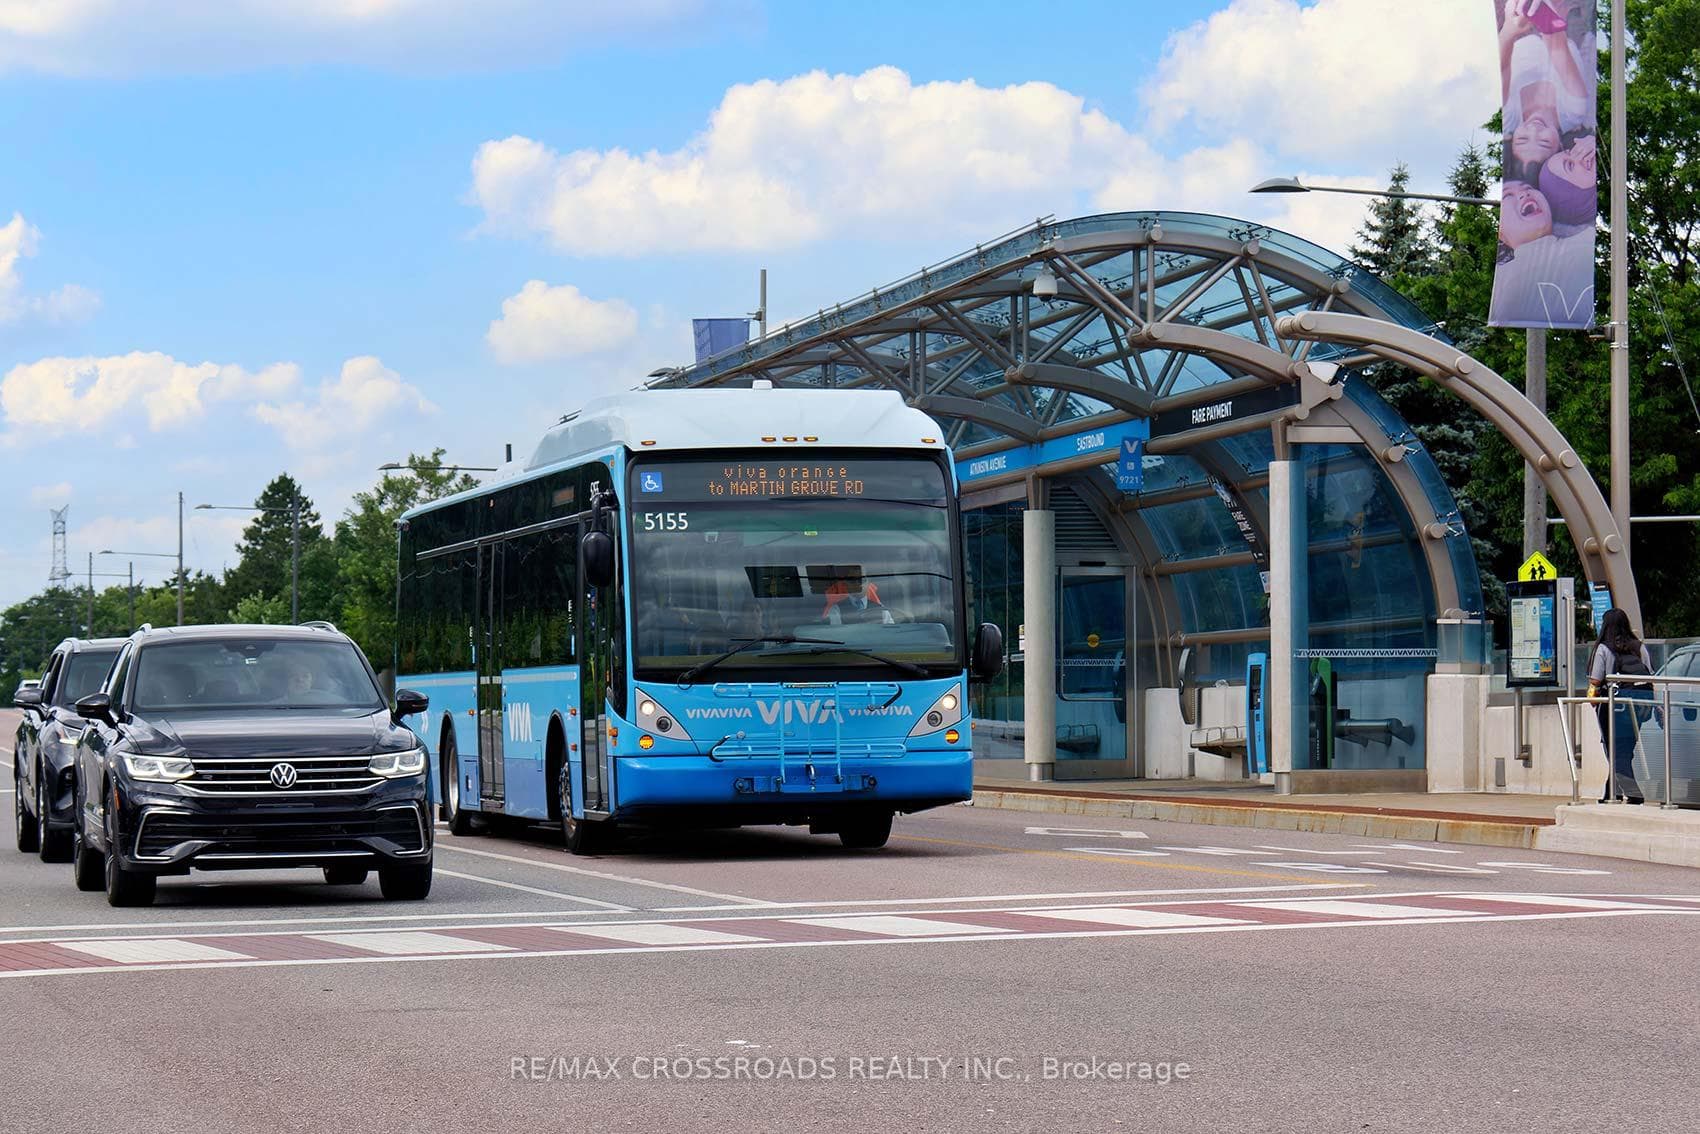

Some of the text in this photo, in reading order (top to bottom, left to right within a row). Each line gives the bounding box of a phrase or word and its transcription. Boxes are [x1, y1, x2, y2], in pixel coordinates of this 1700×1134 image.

[1191, 401, 1233, 424] FARE PAYMENT
[724, 464, 848, 479] viva orange
[1119, 475, 1140, 484] 9721
[709, 480, 864, 496] to MARTIN GROVE RD
[644, 512, 689, 530] 5155
[686, 707, 752, 719] VIVAVIVA
[756, 699, 844, 725] VIVA
[507, 702, 533, 743] VIVA
[1061, 844, 1464, 857] ONLY
[1247, 861, 1613, 875] BUS
